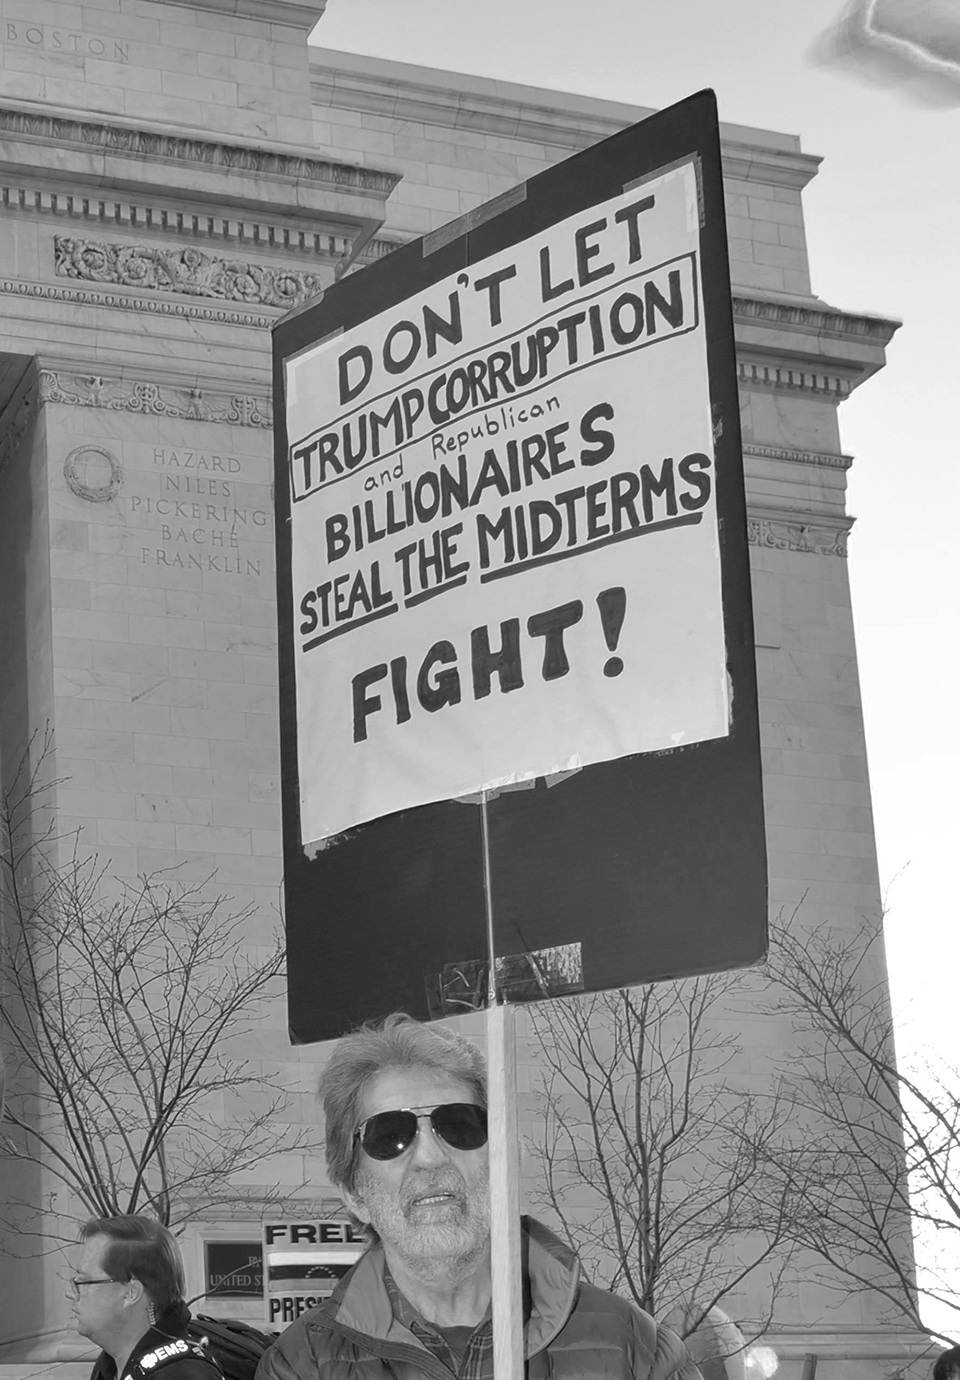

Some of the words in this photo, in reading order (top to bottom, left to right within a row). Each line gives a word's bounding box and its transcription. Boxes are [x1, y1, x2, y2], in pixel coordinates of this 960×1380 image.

[5, 22, 132, 62] BOSTON
[338, 265, 517, 406] DON'T
[541, 195, 656, 302] LET
[363, 458, 405, 491] and
[431, 396, 560, 459] Republican
[153, 449, 241, 473] HAZARD
[166, 475, 231, 497] NILES
[327, 402, 615, 565] BILLIONAIRES
[131, 495, 267, 526] PICKERING
[161, 524, 239, 548] BACHE
[300, 562, 393, 636] STEAL
[395, 523, 470, 590] THE
[476, 452, 712, 569] MIDTERMS
[141, 547, 261, 576] FRANKLIN
[352, 587, 627, 743] FIGHT!
[210, 1274, 252, 1287] UNITED
[154, 1339, 189, 1361] EMS
